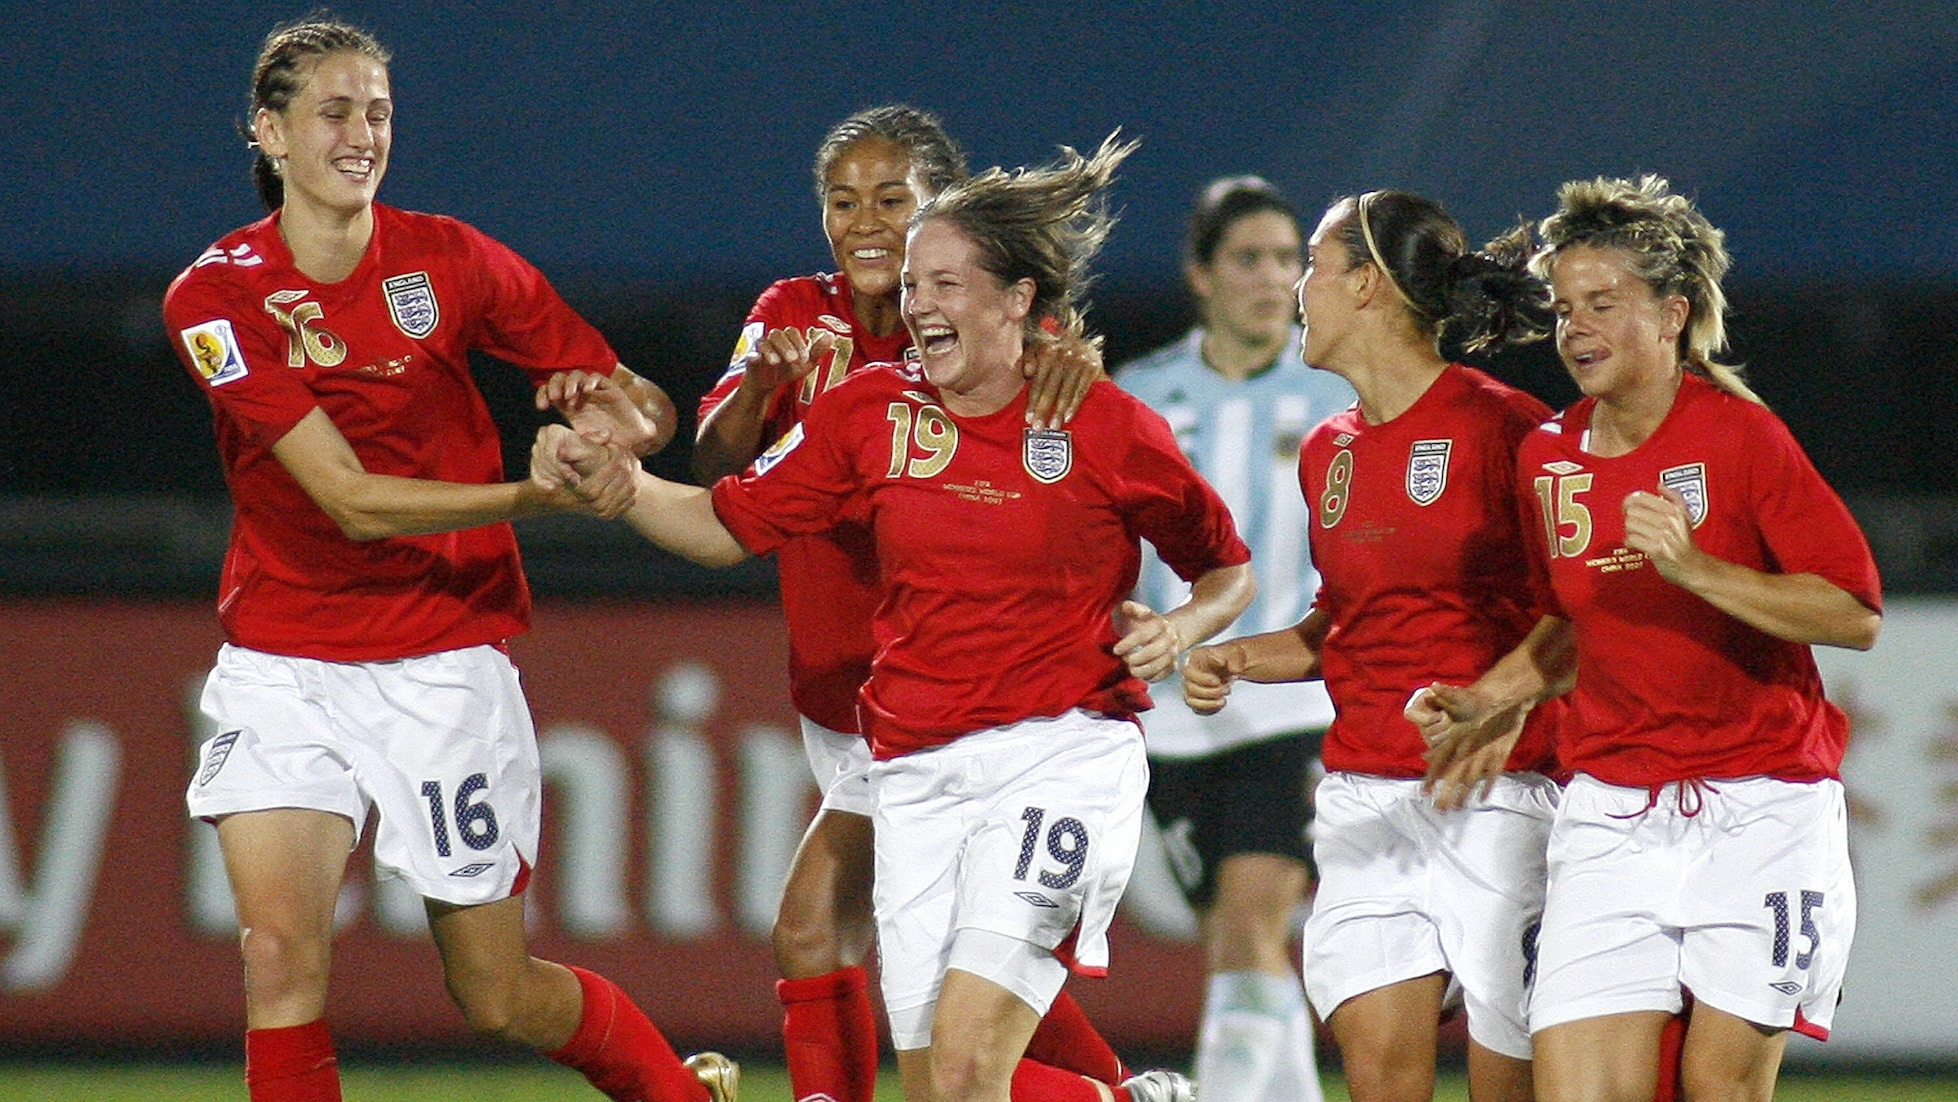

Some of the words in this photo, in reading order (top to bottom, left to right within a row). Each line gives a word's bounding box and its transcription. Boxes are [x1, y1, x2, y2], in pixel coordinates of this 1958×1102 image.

[266, 301, 347, 368] 16
[886, 402, 959, 479] 19
[1320, 449, 1354, 529] 8
[1534, 473, 1594, 559] 15
[421, 773, 499, 857] 16
[1013, 806, 1088, 889] 19
[1764, 890, 1824, 970] 15
